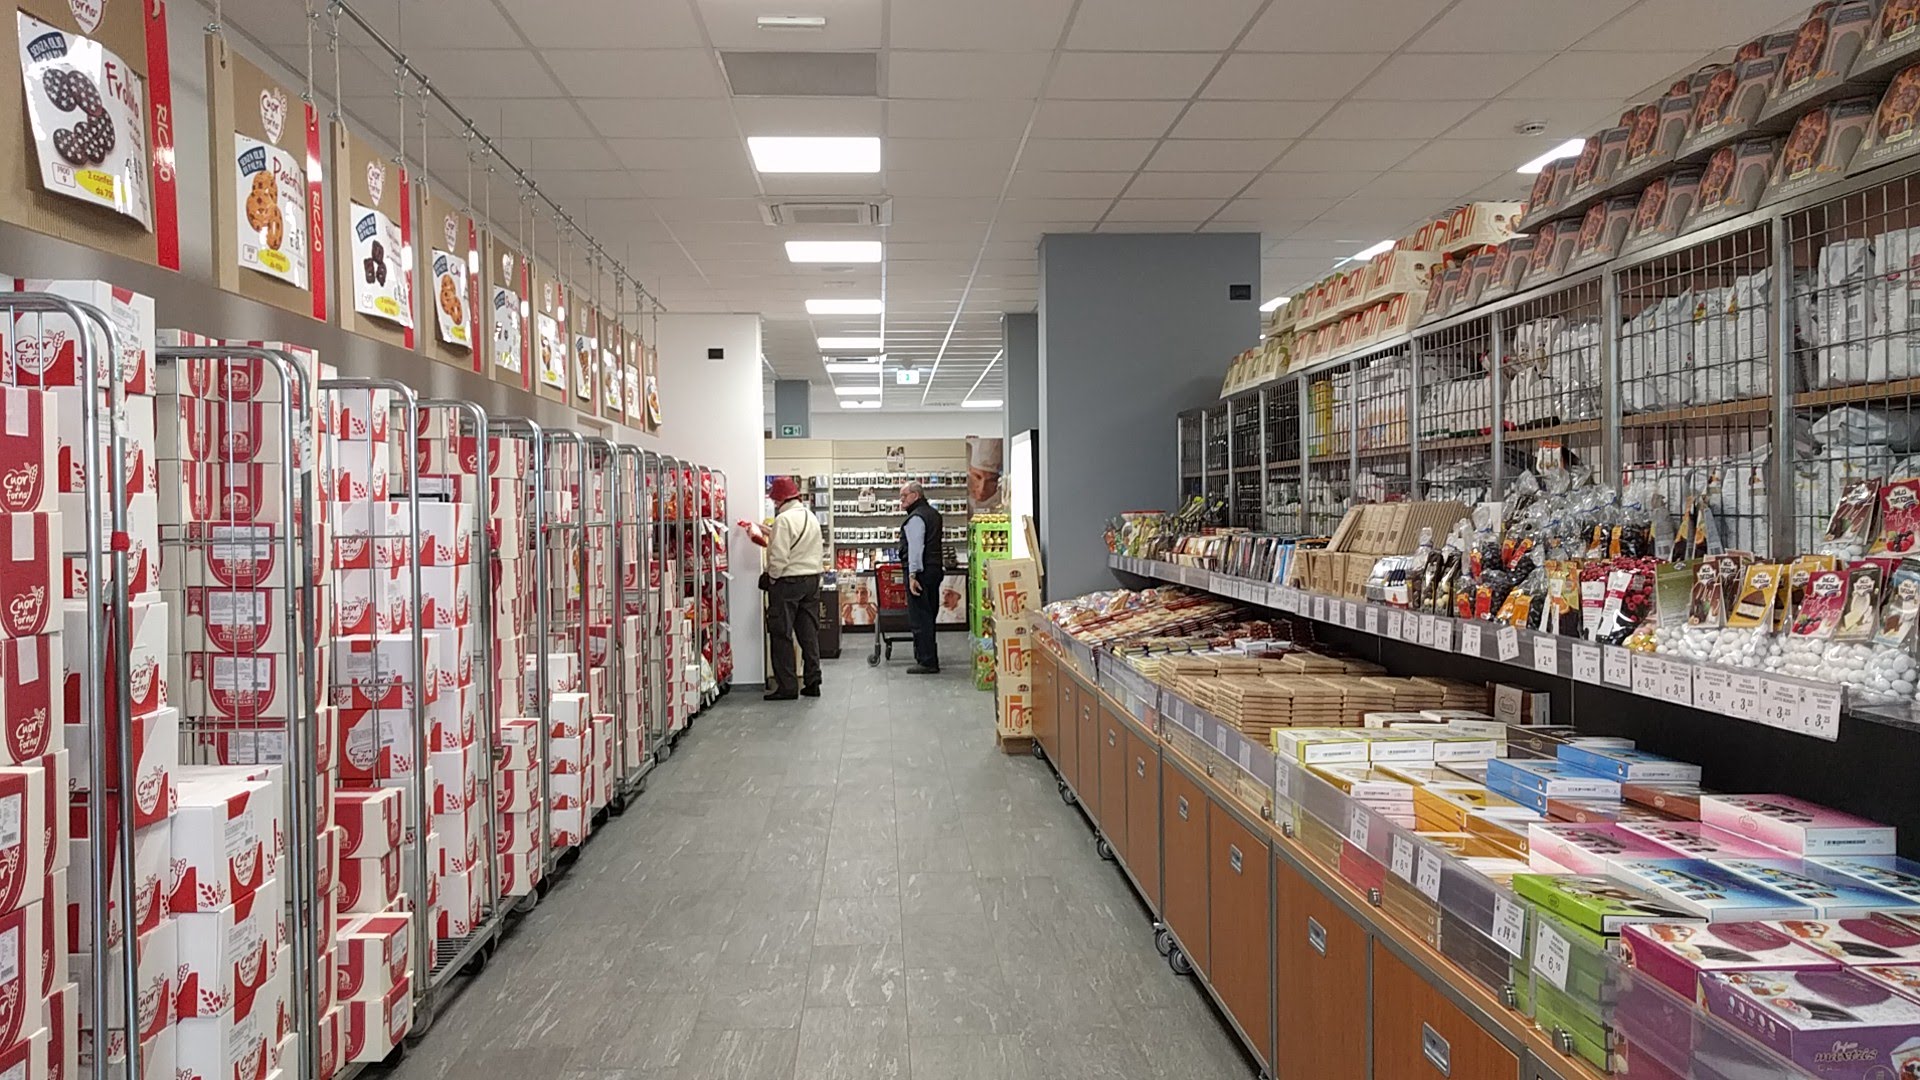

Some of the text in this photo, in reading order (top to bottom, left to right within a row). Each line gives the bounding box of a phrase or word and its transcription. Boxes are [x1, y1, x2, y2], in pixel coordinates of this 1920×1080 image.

[156, 103, 171, 182] RICO
[312, 190, 322, 252] RICCO
[3, 473, 28, 489] Cuor
[6, 489, 27, 502] forno
[10, 597, 35, 615] Cuor
[13, 613, 35, 628] forno
[130, 667, 148, 683] Cuor
[15, 720, 38, 740] Cuor
[18, 737, 38, 752] forno
[138, 777, 156, 795] Cuor
